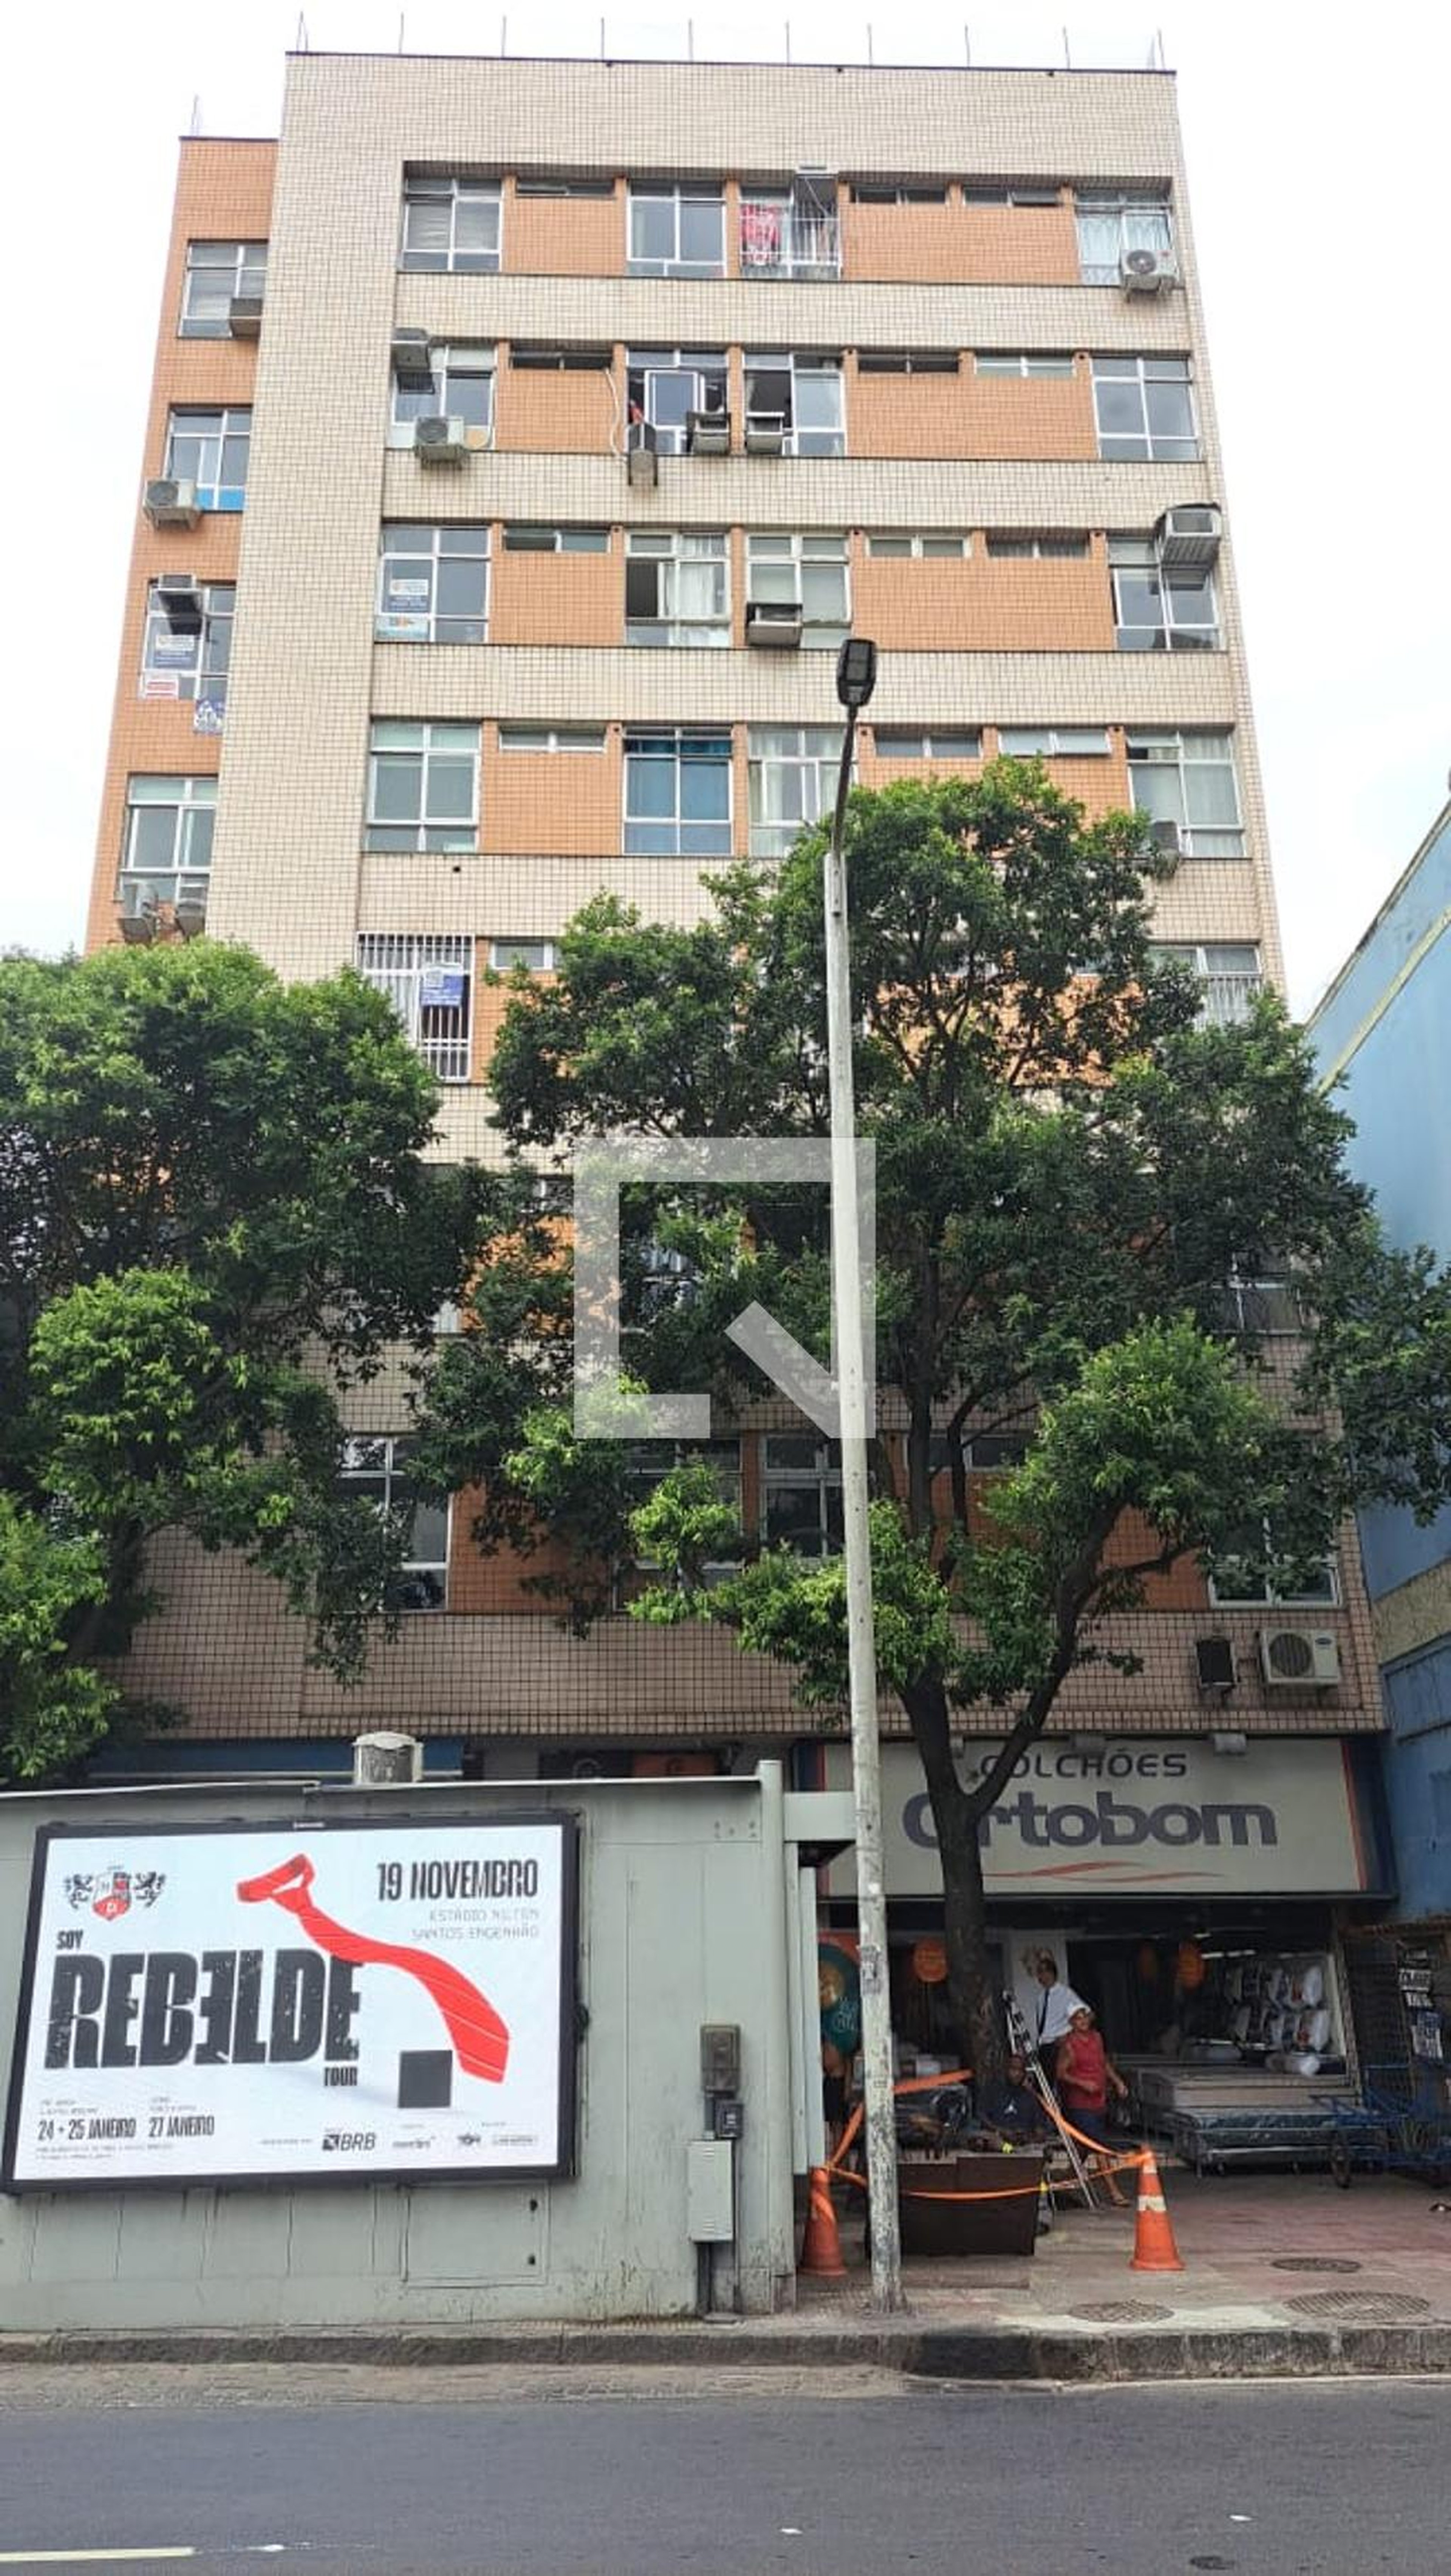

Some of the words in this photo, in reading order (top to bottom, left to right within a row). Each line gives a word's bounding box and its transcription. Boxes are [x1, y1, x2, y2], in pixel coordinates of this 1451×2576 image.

[377, 1862, 402, 1901] 19
[410, 1859, 538, 1900] NOVEMBRO
[57, 1930, 84, 1950] SOY
[324, 2067, 358, 2087] TOUR
[38, 2120, 54, 2141] 24
[68, 2119, 85, 2140] 25
[88, 2117, 137, 2140] JANEIRO
[149, 2117, 165, 2137] 27
[167, 2115, 215, 2137] JANEIRO
[340, 2132, 376, 2151] BRB
